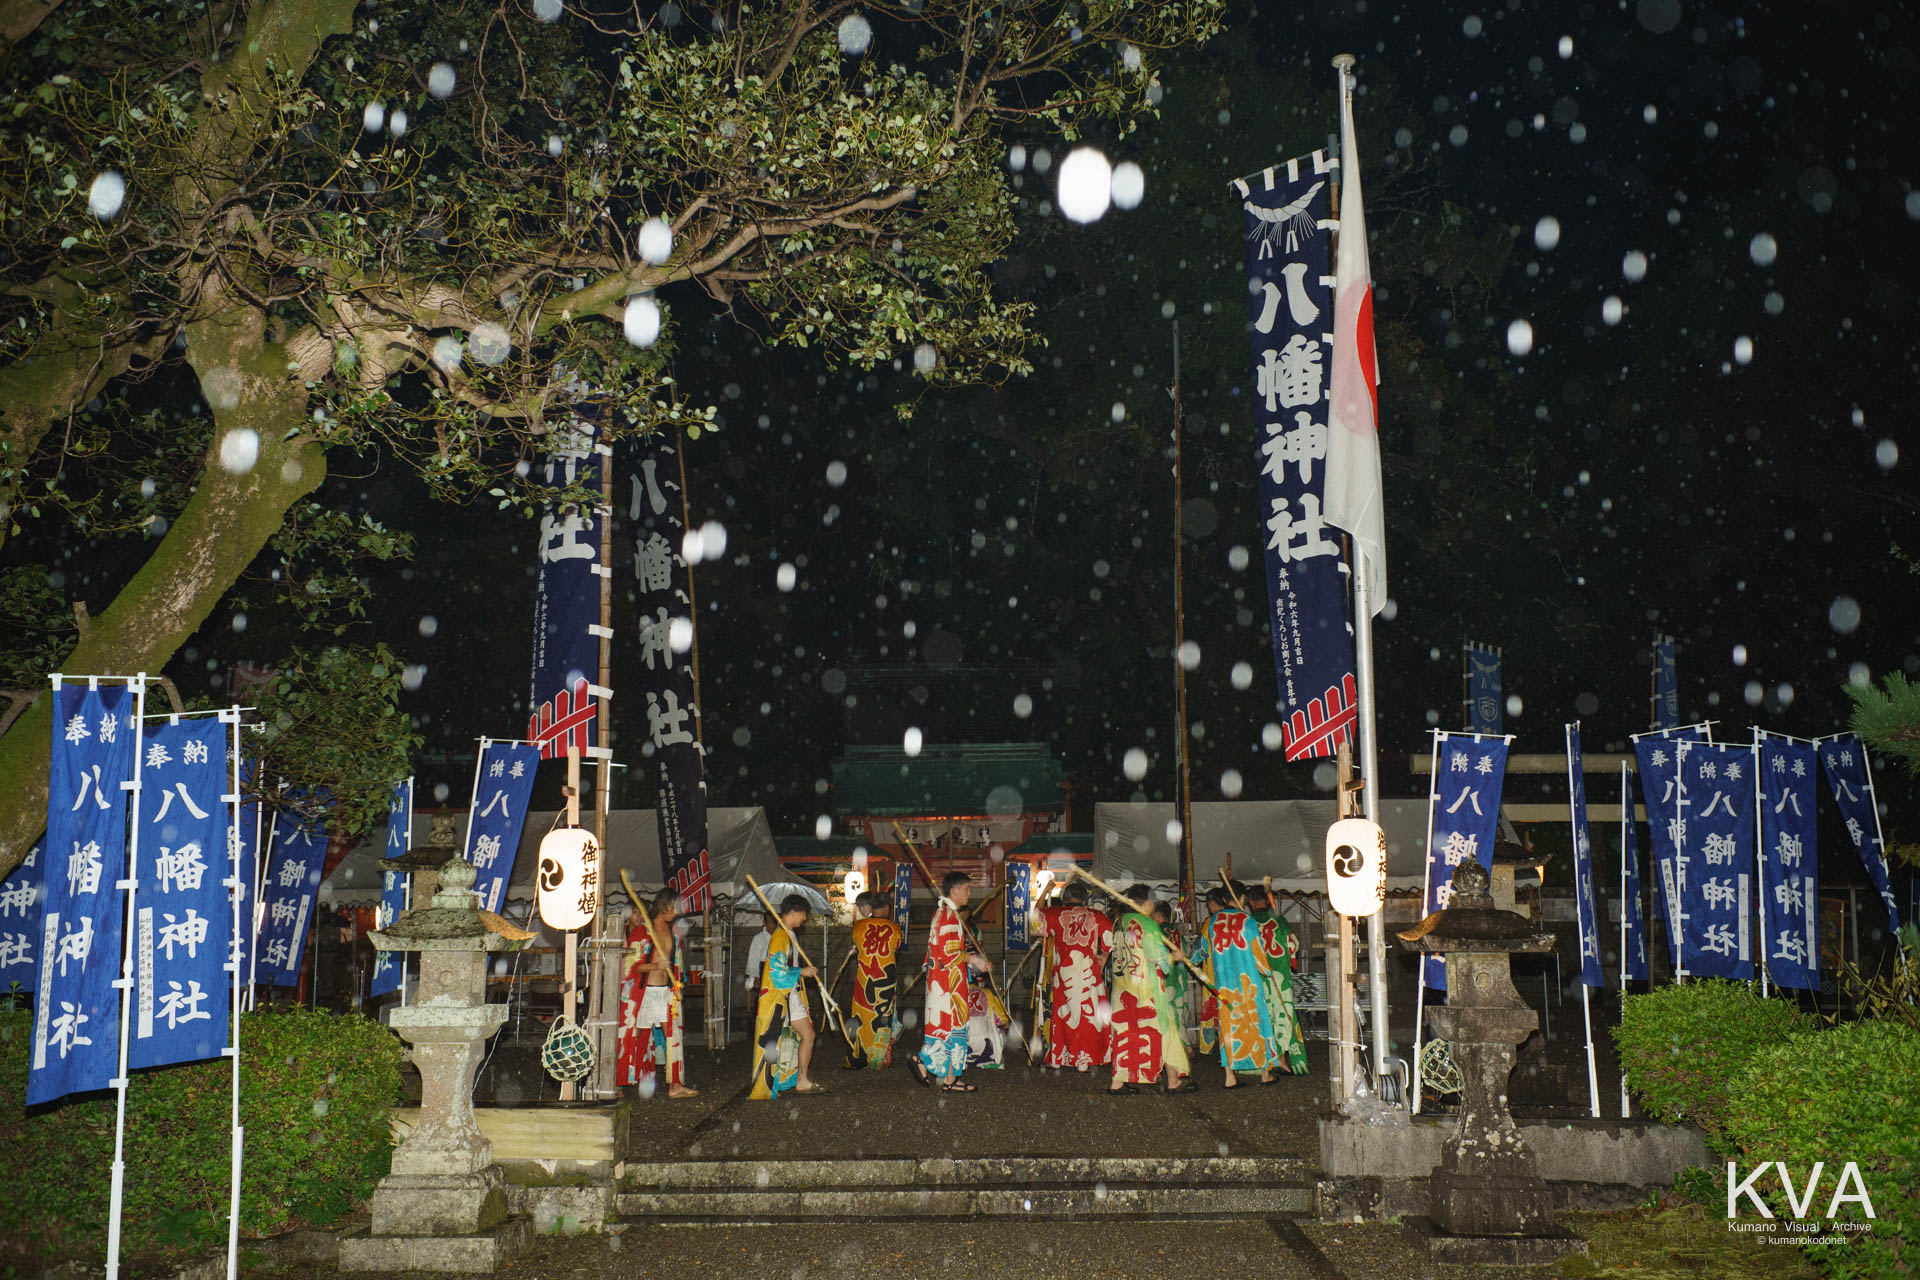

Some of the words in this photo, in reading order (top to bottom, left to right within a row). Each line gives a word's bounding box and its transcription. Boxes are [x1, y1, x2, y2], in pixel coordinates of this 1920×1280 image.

[1255, 263, 1340, 563] 八幡神社
[1278, 568, 1290, 591] 奉納
[630, 459, 693, 748] 八幡神社
[1287, 591, 1304, 665] 令和六年九月吉日
[64, 712, 118, 745] 奉納
[145, 740, 209, 769] 奉納
[1827, 751, 1853, 771] 奉納
[48, 765, 112, 1059] 八幡神社
[153, 782, 212, 1030] 八幡神社
[863, 923, 894, 956] 祝
[1213, 912, 1248, 954] 祝
